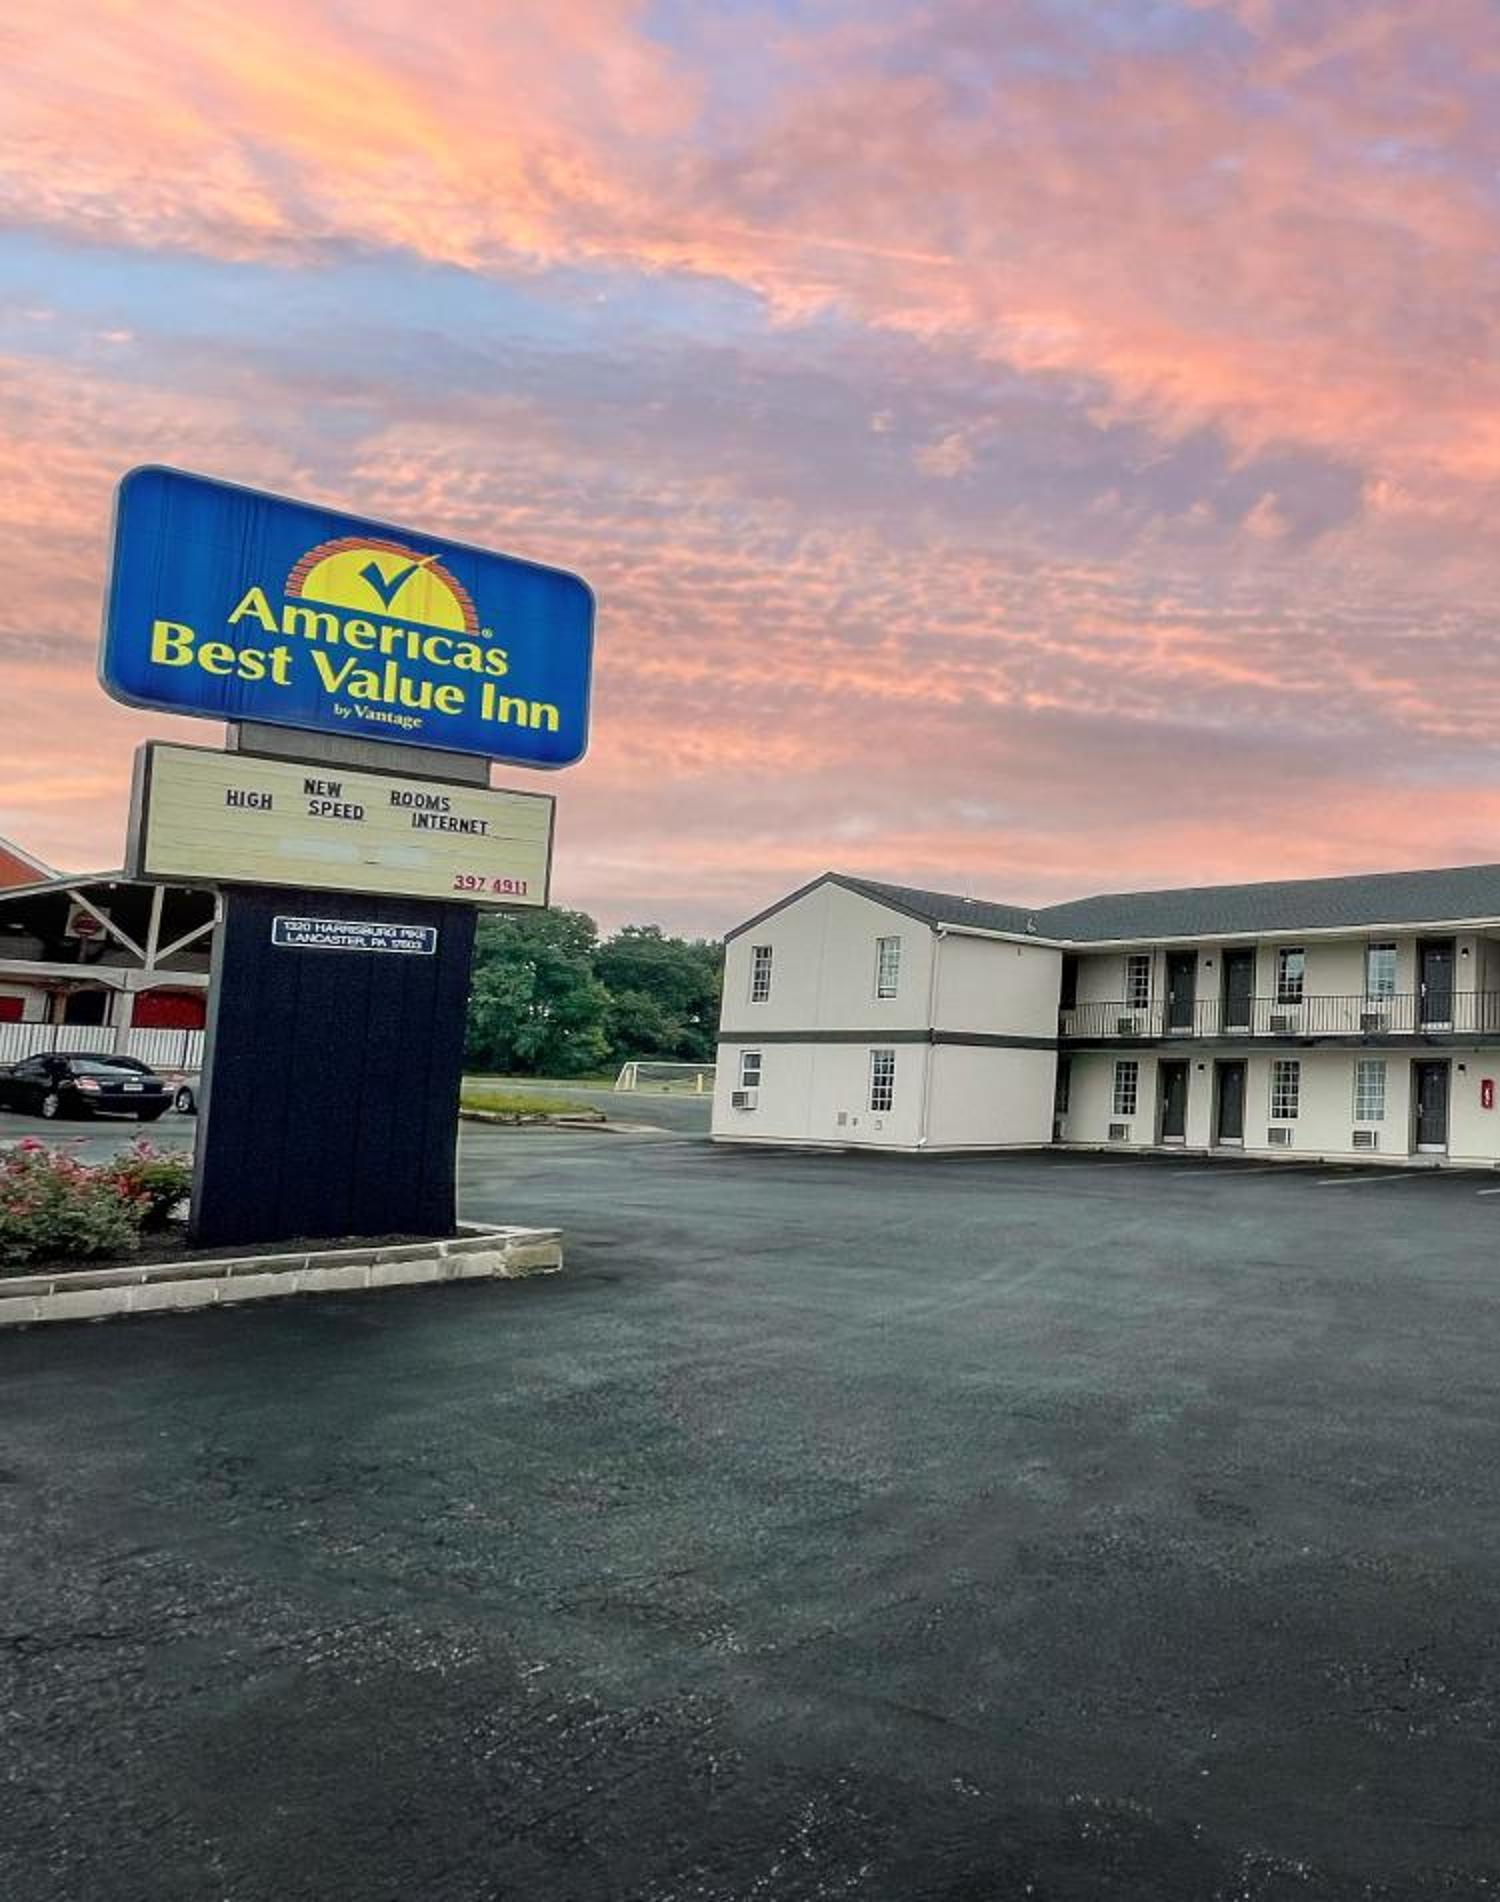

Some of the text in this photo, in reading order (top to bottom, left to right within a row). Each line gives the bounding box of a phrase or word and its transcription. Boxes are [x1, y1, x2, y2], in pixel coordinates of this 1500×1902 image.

[227, 586, 509, 676] Americas
[149, 619, 560, 732] Best Value Inn
[333, 703, 423, 730] by Vantage
[303, 779, 451, 811] NEW ROOMS
[226, 789, 489, 836] HIGH SPEED INTERNET
[453, 875, 528, 896] 397 4911
[287, 932, 367, 947] LANCASTER,
[371, 938, 387, 947] PA
